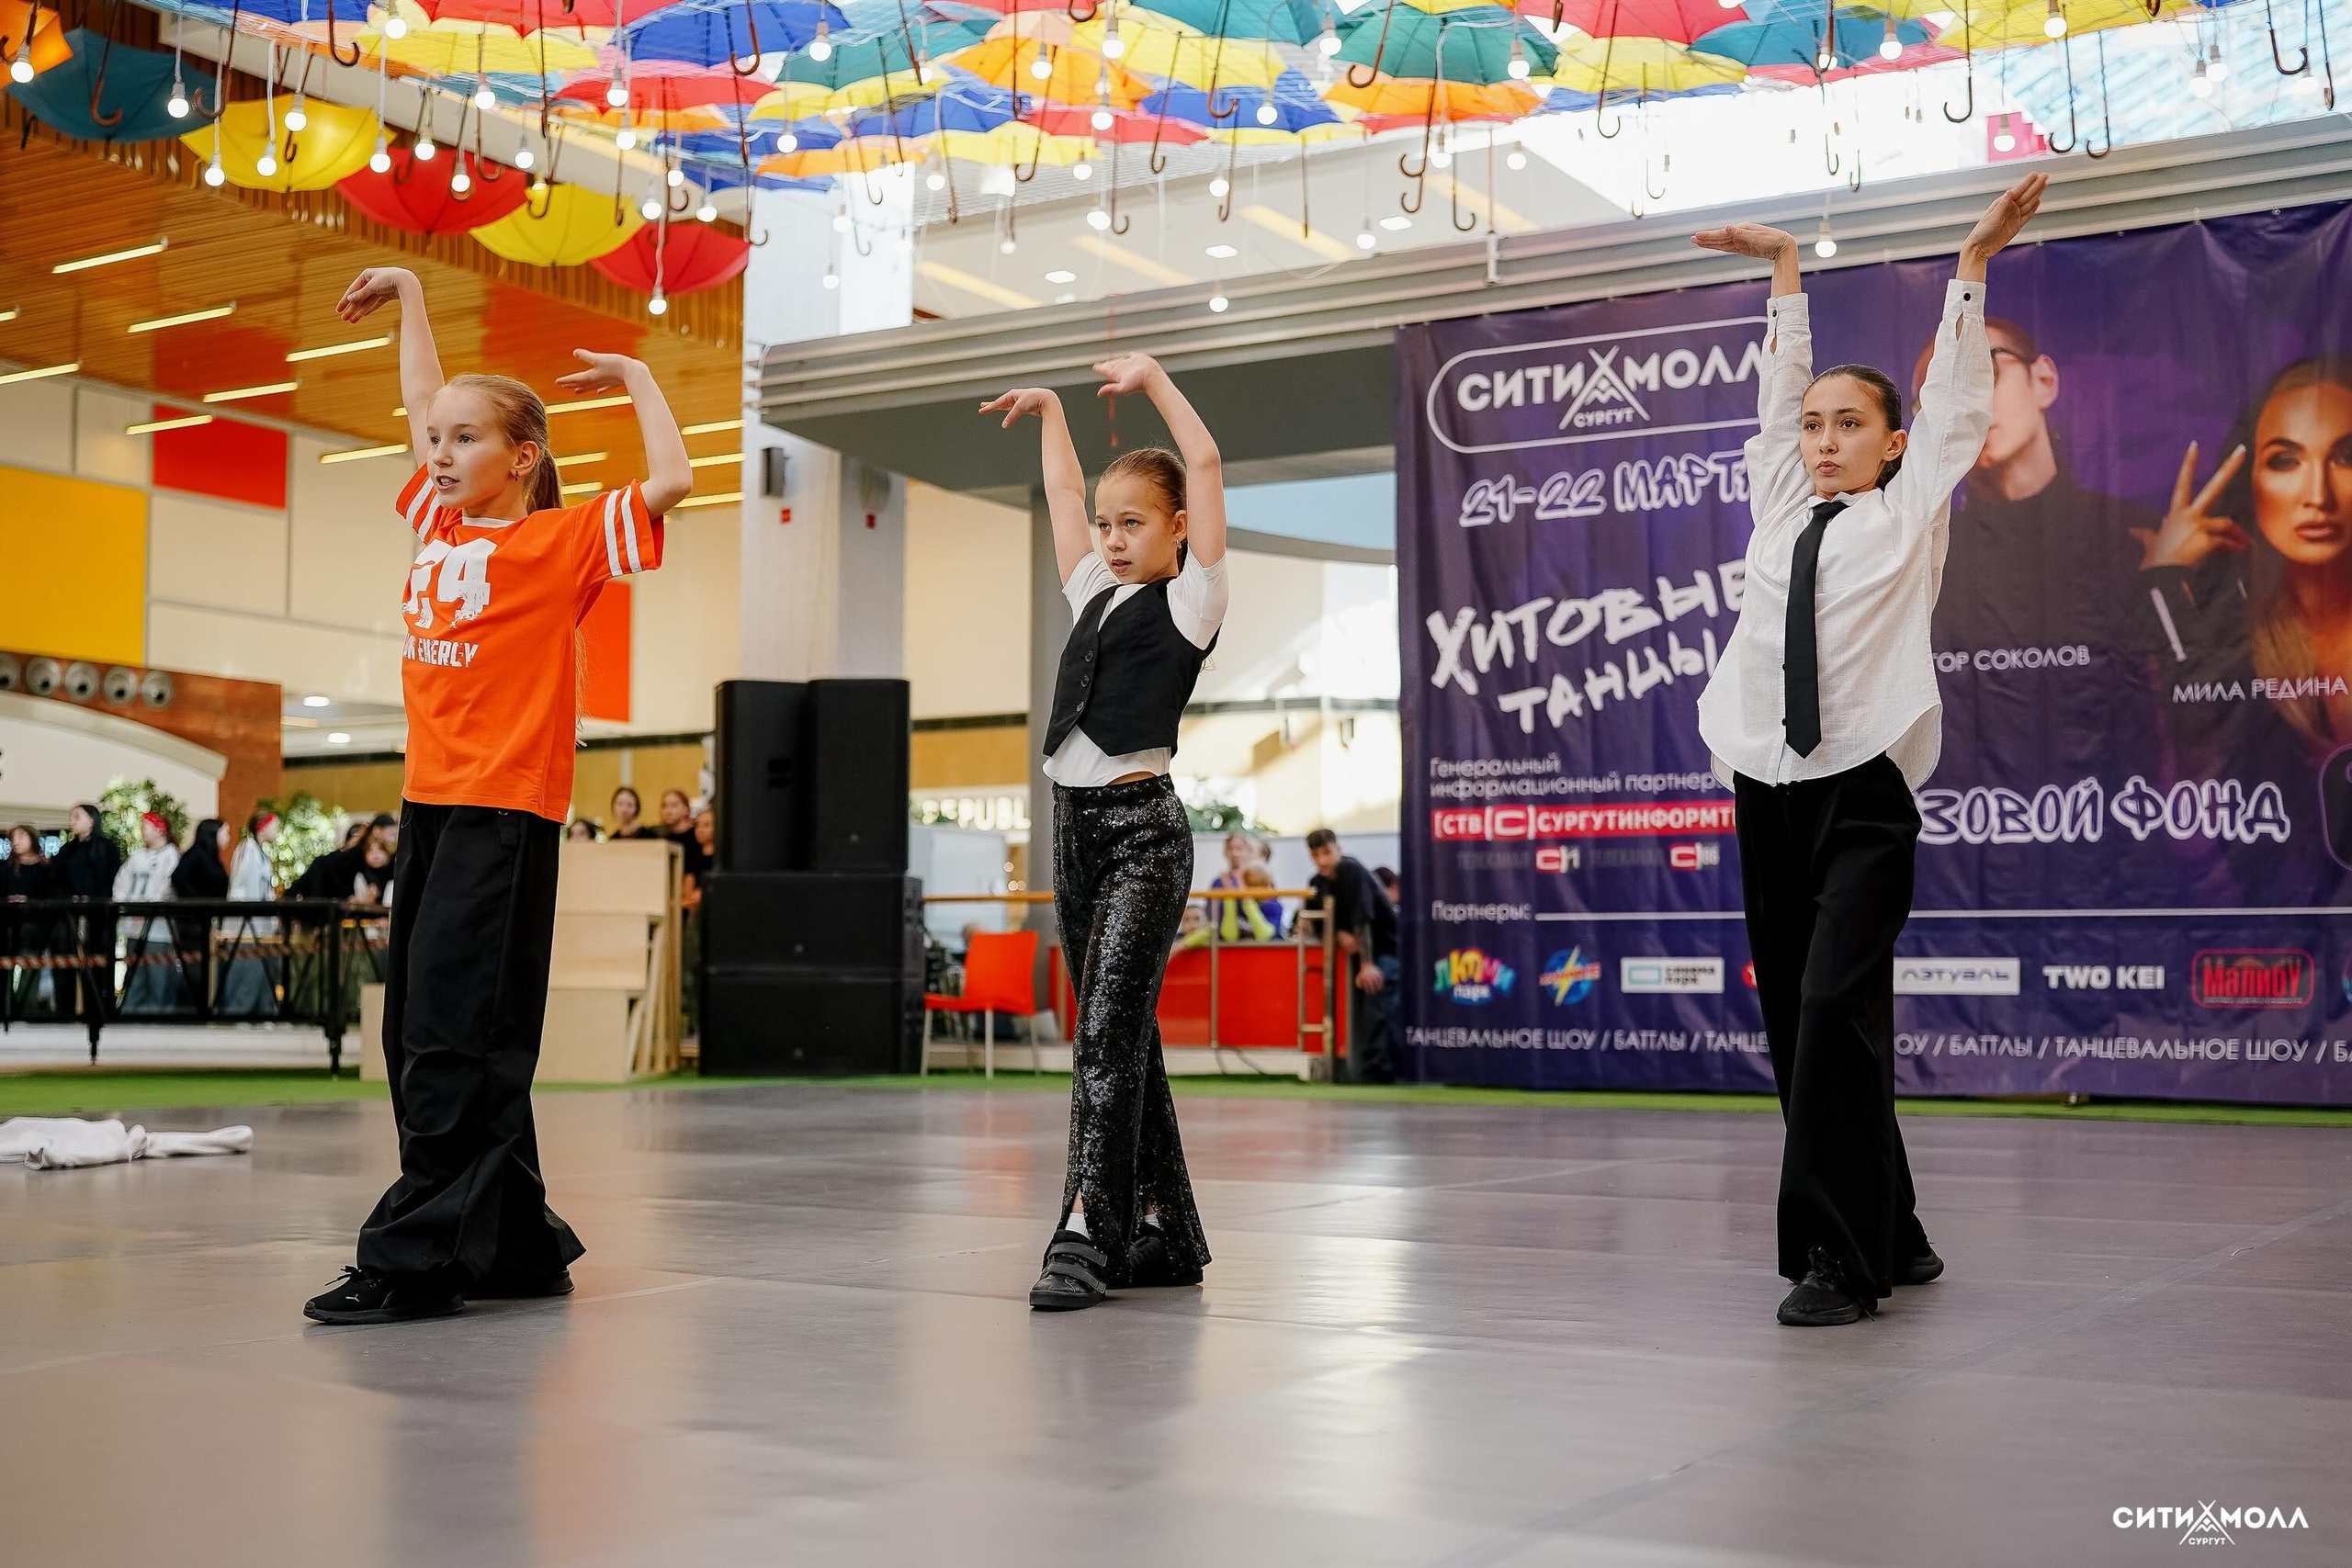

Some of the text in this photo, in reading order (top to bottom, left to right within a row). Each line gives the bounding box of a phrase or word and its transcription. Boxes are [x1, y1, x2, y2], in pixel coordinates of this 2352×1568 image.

[1457, 361, 1585, 412] СИТИ
[1572, 407, 1636, 429] СУРГУТ
[1458, 468, 1607, 528] 21-22
[1426, 558, 1746, 696] ХИТОВЫЕ
[1973, 644, 2091, 671] СОКОЛОВ
[1498, 628, 1720, 734] ТАНЦЫ
[2172, 674, 2349, 704] МИЛА РЕДИНА
[1430, 751, 1562, 779] Генеральный
[1430, 771, 1621, 802] информационный
[1537, 806, 1735, 834] СУРГУТИНФОРМТ
[1914, 774, 2291, 846] ЗОВОЙ ФОНД
[1431, 900, 1532, 924] Партнеры:
[2041, 964, 2165, 990] TWO KEI
[1405, 1026, 1544, 1049] ТАНЦЕВАЛЬНОЕ
[1546, 1028, 1598, 1051] ШОУ
[1613, 1029, 1688, 1051] БАТТЛЫ
[1702, 1030, 1770, 1054] ТАНЦЕ
[1894, 1033, 1929, 1056] ОУ
[1949, 1034, 2033, 1056] БАТТЛЫ
[2053, 1036, 2240, 1060] ТАНЦЕВАЛЬНОЕ
[2245, 1038, 2309, 1062] ШОУ
